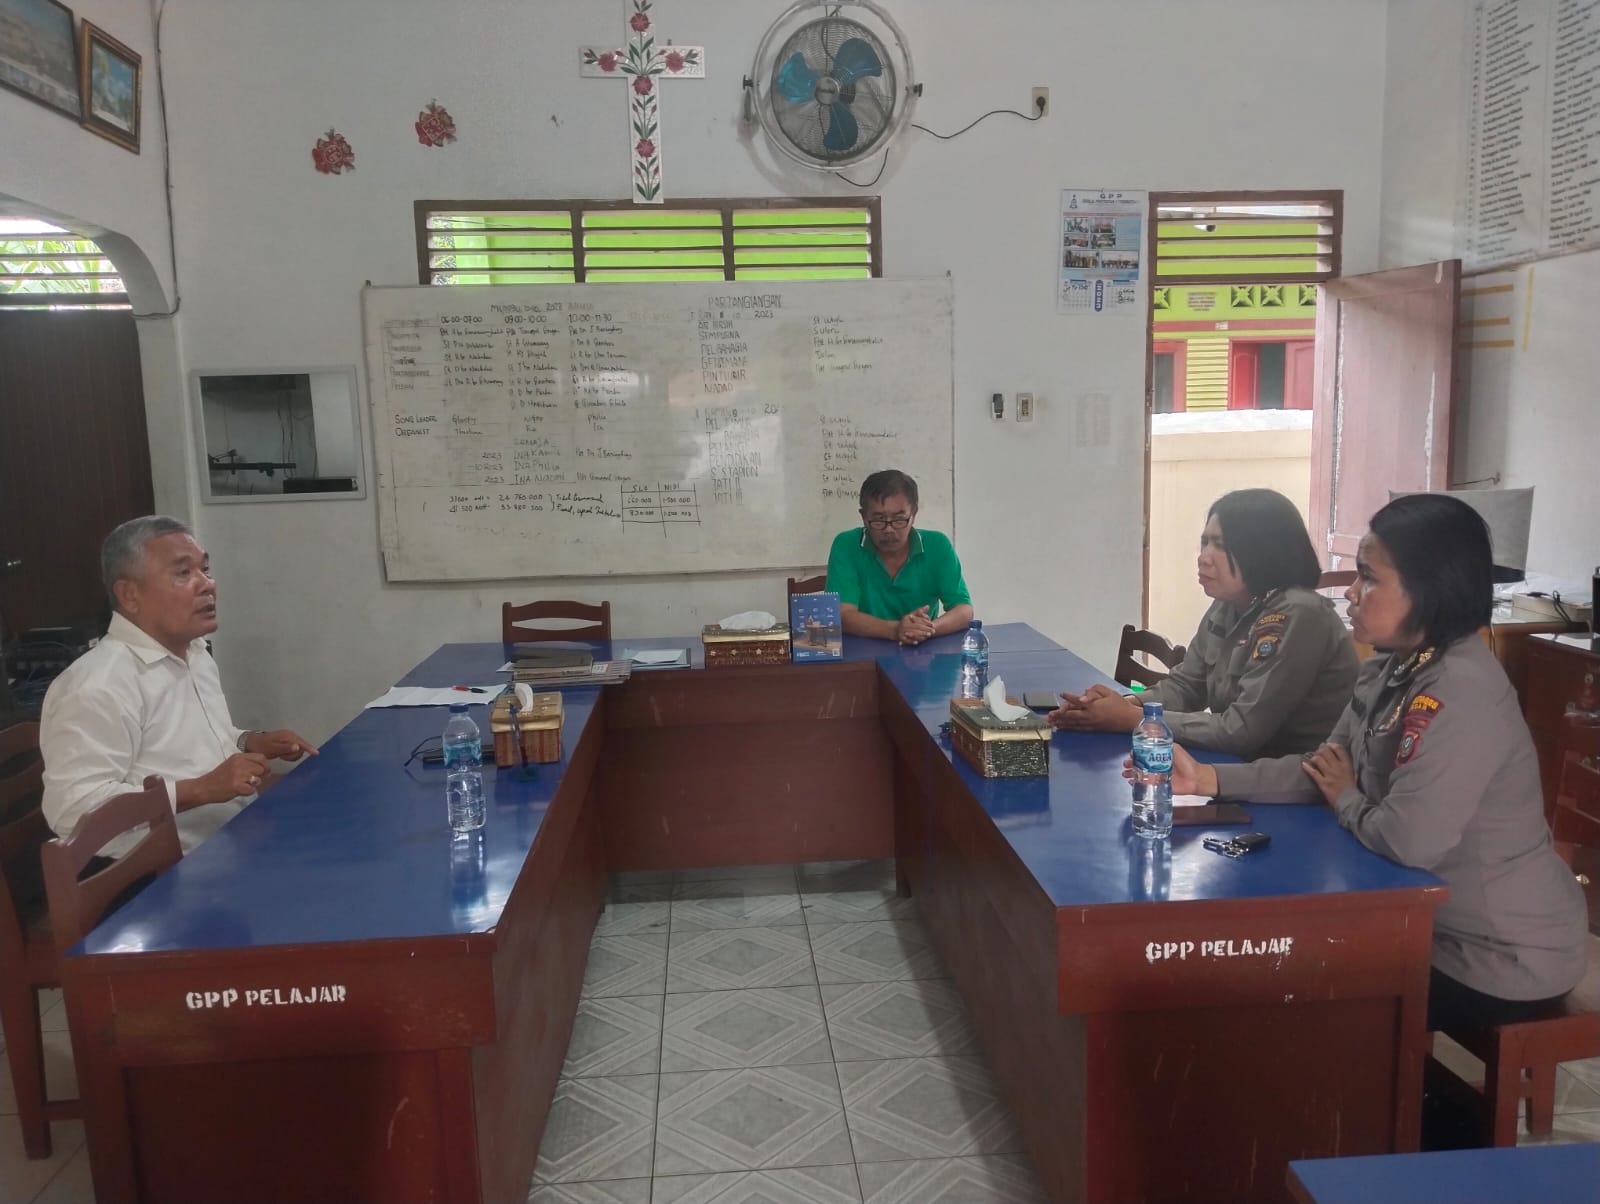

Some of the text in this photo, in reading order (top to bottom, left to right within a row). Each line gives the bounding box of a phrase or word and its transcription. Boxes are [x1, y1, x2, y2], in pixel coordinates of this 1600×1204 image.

[1147, 752, 1172, 763] AQUA
[1145, 937, 1294, 962] GPP PELAJAR
[185, 984, 347, 1010] GPP PELAJAR
